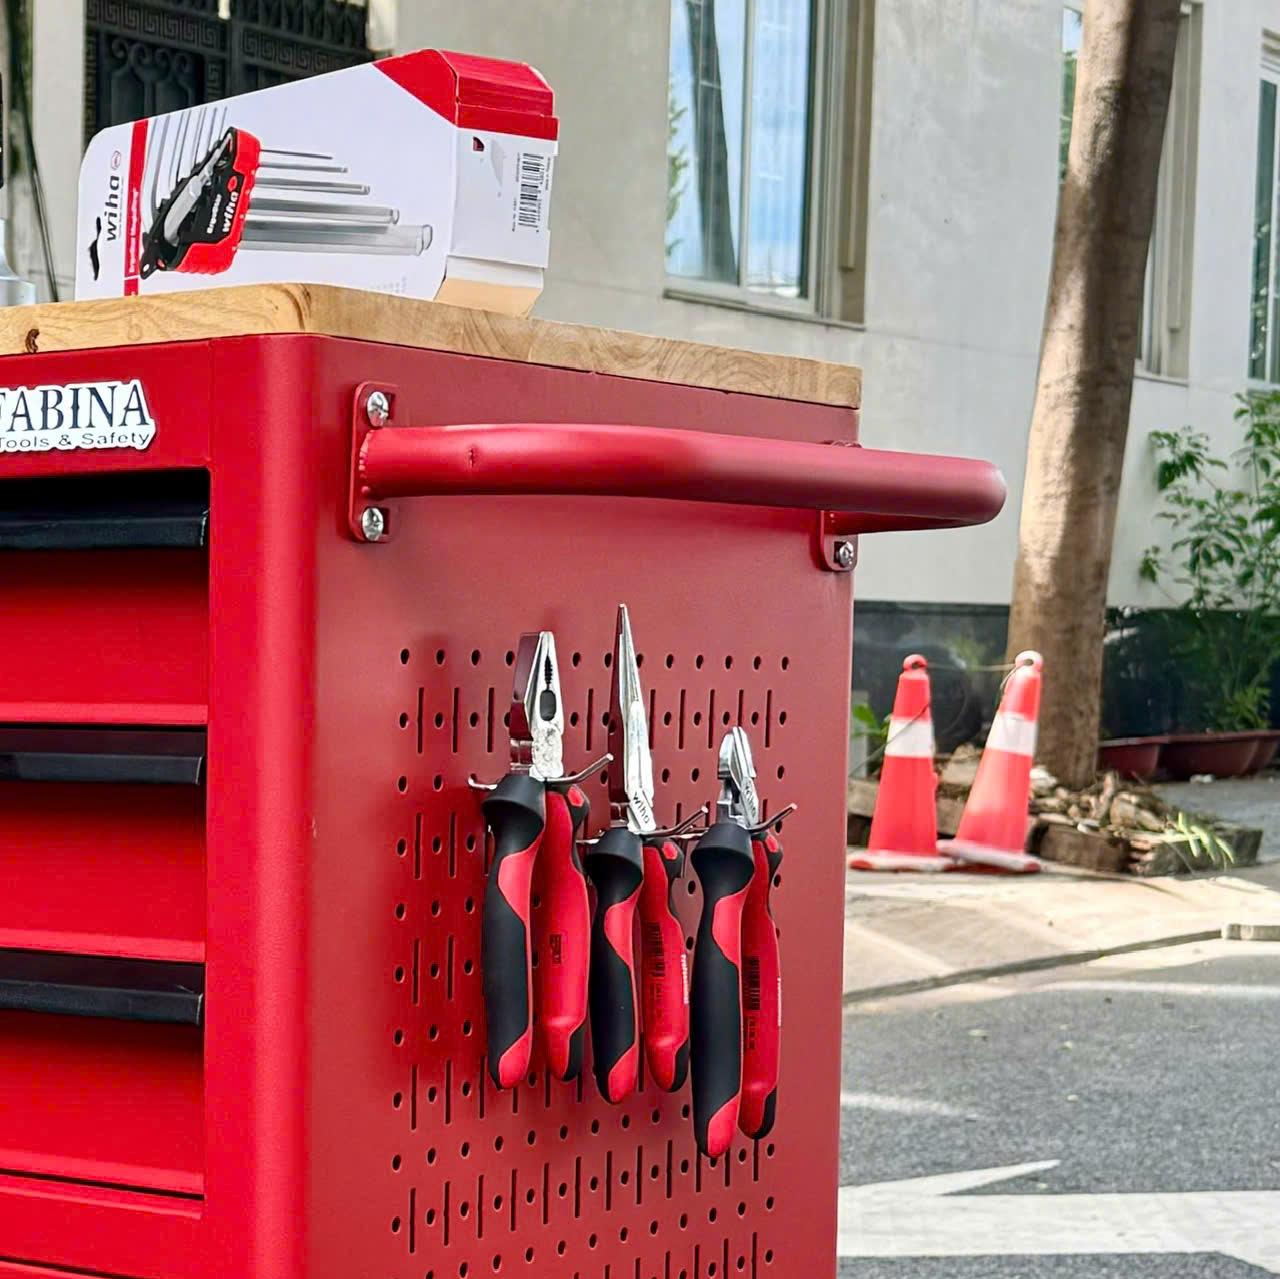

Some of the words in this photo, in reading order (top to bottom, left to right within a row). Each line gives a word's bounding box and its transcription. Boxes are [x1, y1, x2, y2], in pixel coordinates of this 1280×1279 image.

[105, 175, 119, 241] wiha
[222, 191, 239, 233] wiha
[58, 434, 72, 446] &
[82, 431, 150, 446] Safety
[633, 791, 650, 824] wiha
